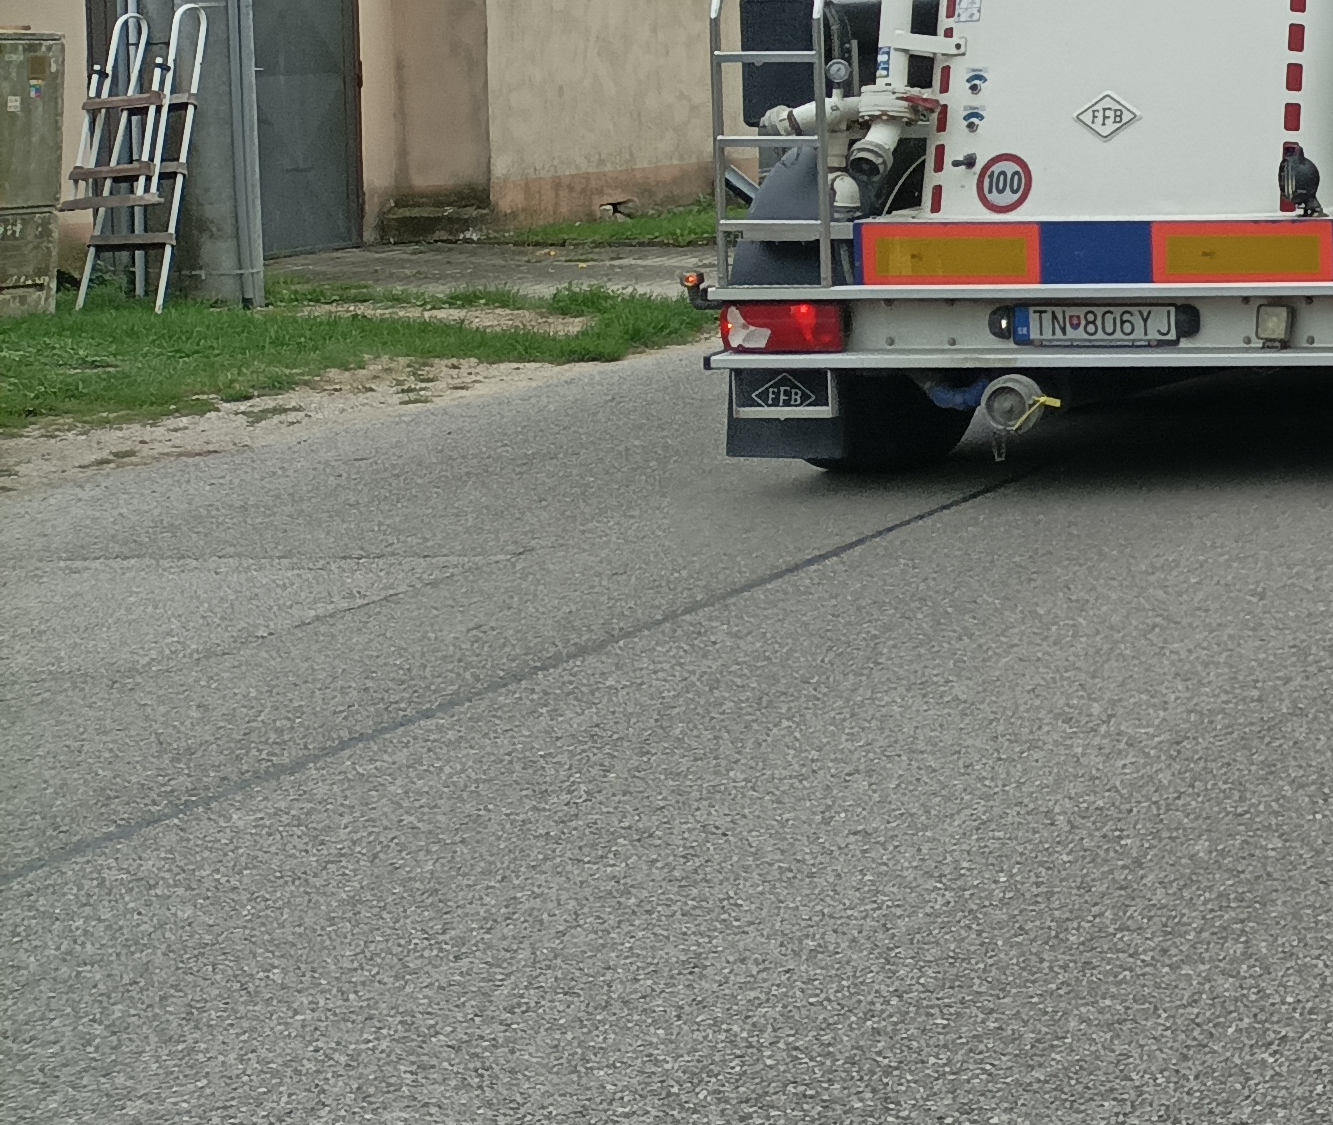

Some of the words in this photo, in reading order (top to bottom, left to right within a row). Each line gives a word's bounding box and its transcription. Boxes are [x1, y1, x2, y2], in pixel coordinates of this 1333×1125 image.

[1091, 107, 1123, 126] FFB
[987, 170, 1022, 194] 100
[1033, 310, 1067, 336] TN
[1083, 310, 1171, 336] 806YJ
[768, 386, 802, 406] FFB
